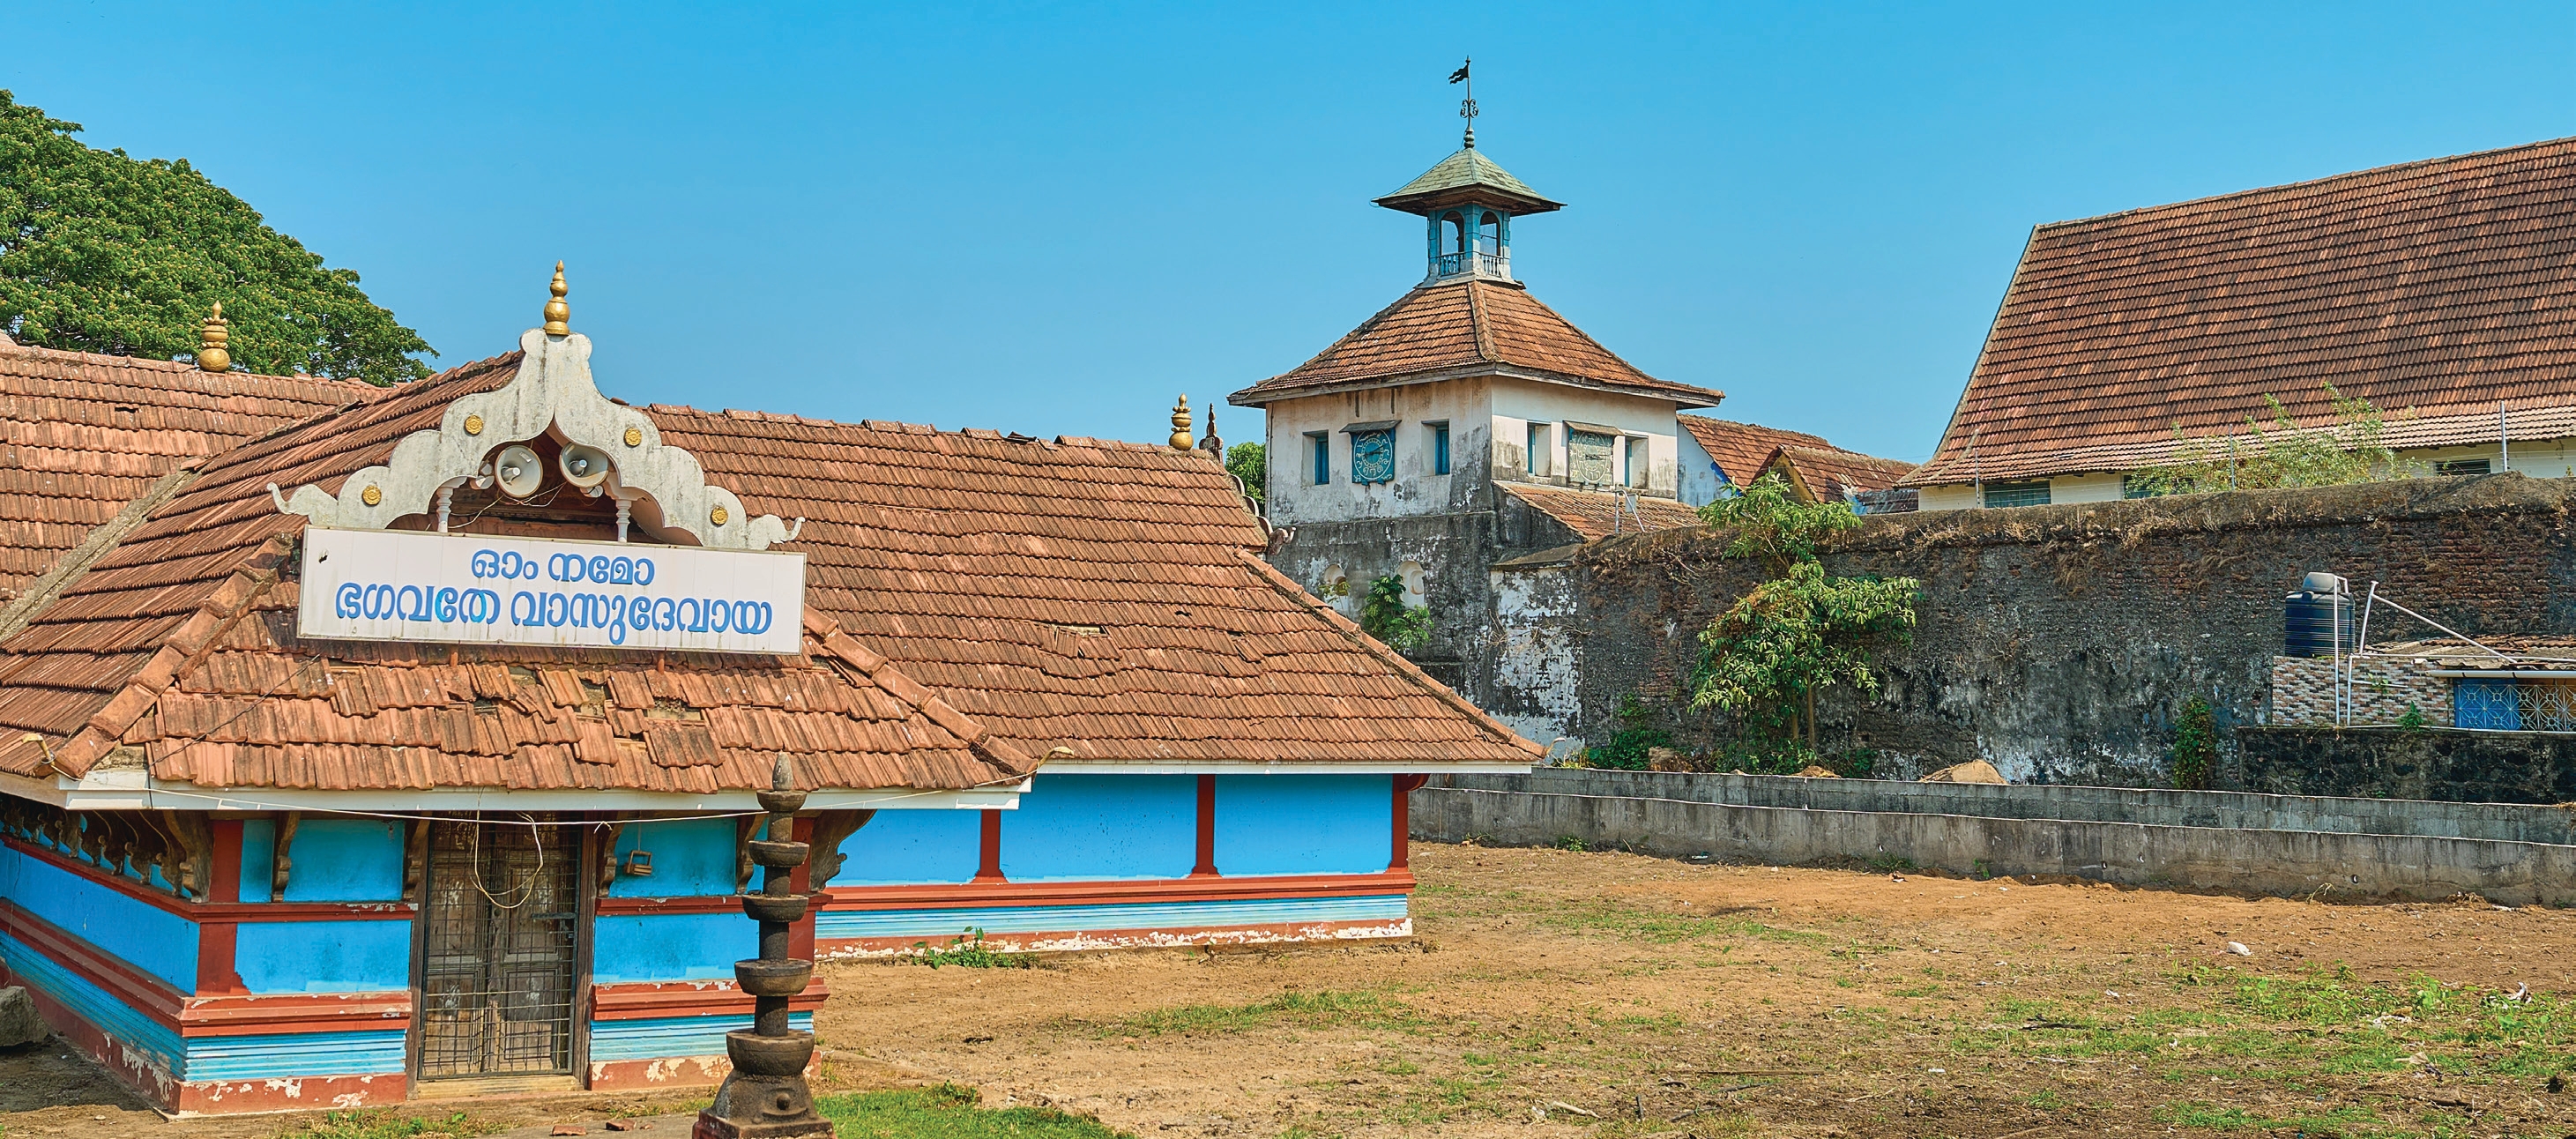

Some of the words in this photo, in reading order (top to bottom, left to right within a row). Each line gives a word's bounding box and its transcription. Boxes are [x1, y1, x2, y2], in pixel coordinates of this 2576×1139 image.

[471, 549, 539, 580] ഓം
[547, 553, 655, 585] നമോ
[335, 582, 501, 625] ഭഗവതേ
[510, 591, 772, 645] വാസുദേവായ
